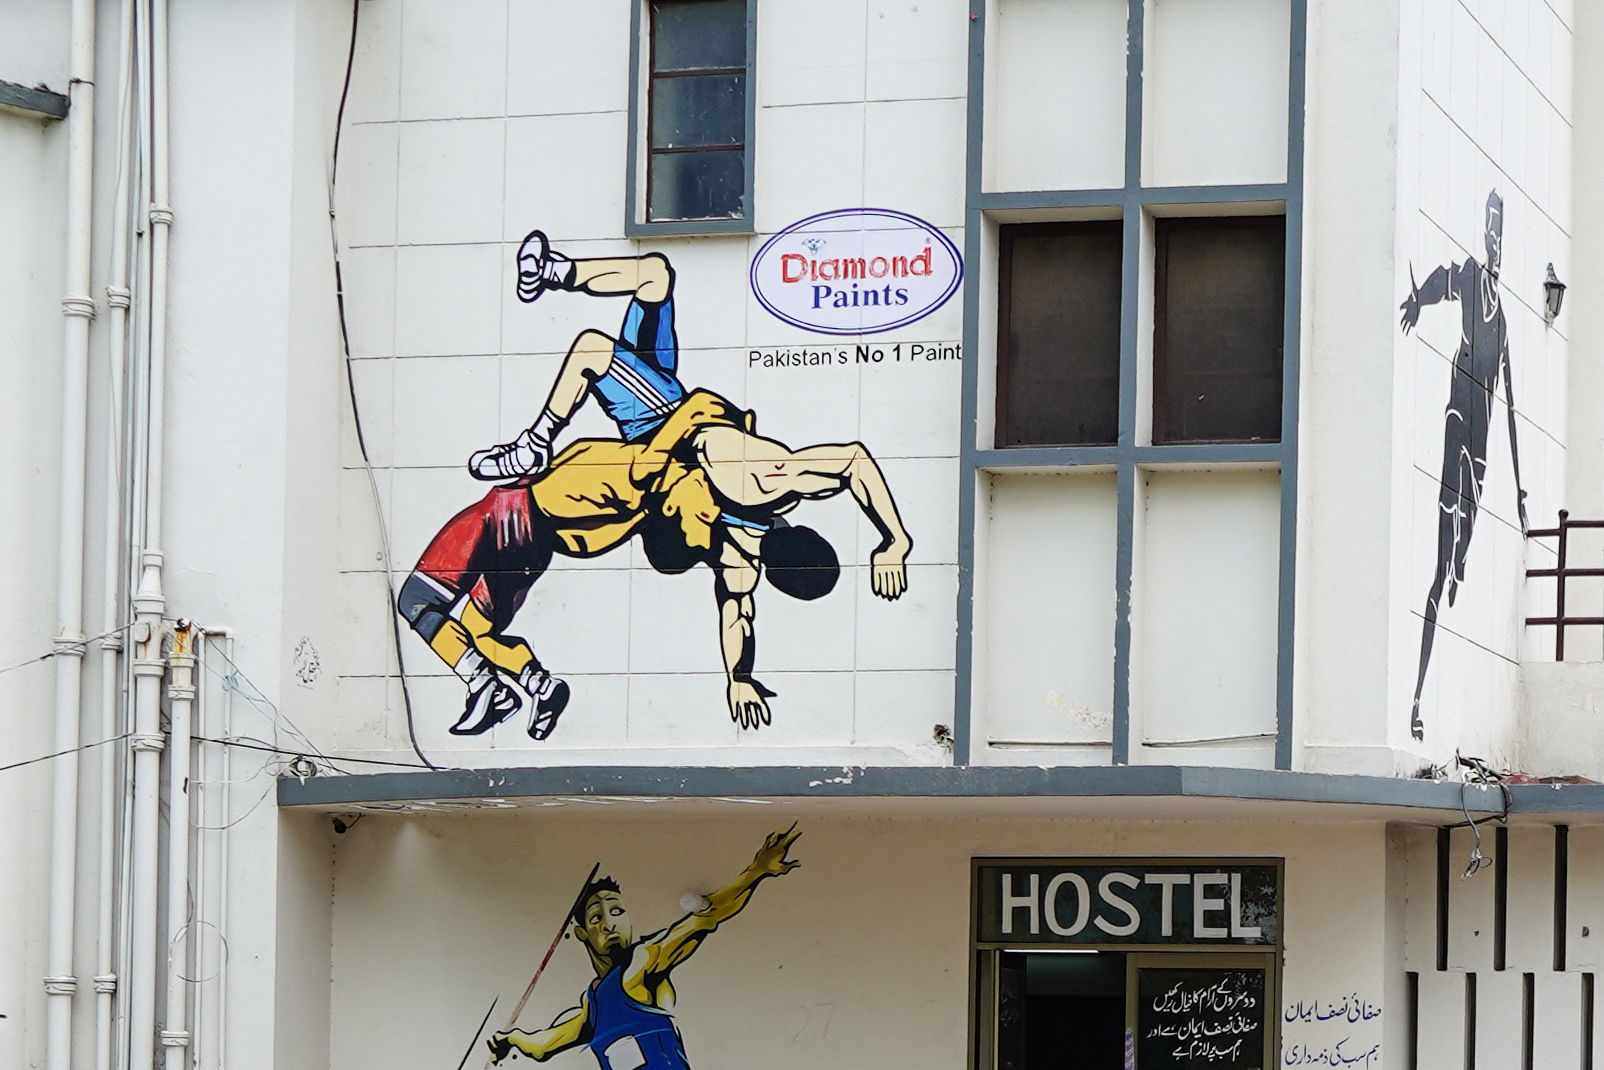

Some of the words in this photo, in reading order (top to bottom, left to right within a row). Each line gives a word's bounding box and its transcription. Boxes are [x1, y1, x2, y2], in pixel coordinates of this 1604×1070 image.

[780, 246, 933, 284] Diamond
[811, 283, 909, 309] Paints
[749, 348, 848, 368] Pakistan's
[855, 345, 884, 364] No
[892, 344, 902, 362] 1
[910, 343, 963, 362] Paint
[1002, 872, 1262, 938] HOSTEL
[1193, 988, 1204, 1003] کا
[1216, 978, 1232, 994] کے
[1213, 991, 1256, 1012] دوسروں
[1285, 1000, 1317, 1022] ایمان
[1317, 996, 1348, 1020] نصف
[1347, 992, 1382, 1023] صفائی
[1146, 1024, 1161, 1038] اور
[1178, 1018, 1204, 1040] ایمان
[1172, 1046, 1190, 1060] ہے
[1190, 1040, 1210, 1060] لازم
[1208, 1045, 1217, 1062] پر
[1215, 1045, 1234, 1059] سب
[1232, 1039, 1243, 1062] ہم
[1330, 1036, 1350, 1066] کی
[1341, 1051, 1366, 1068] سب
[1366, 1044, 1380, 1070] ہم
